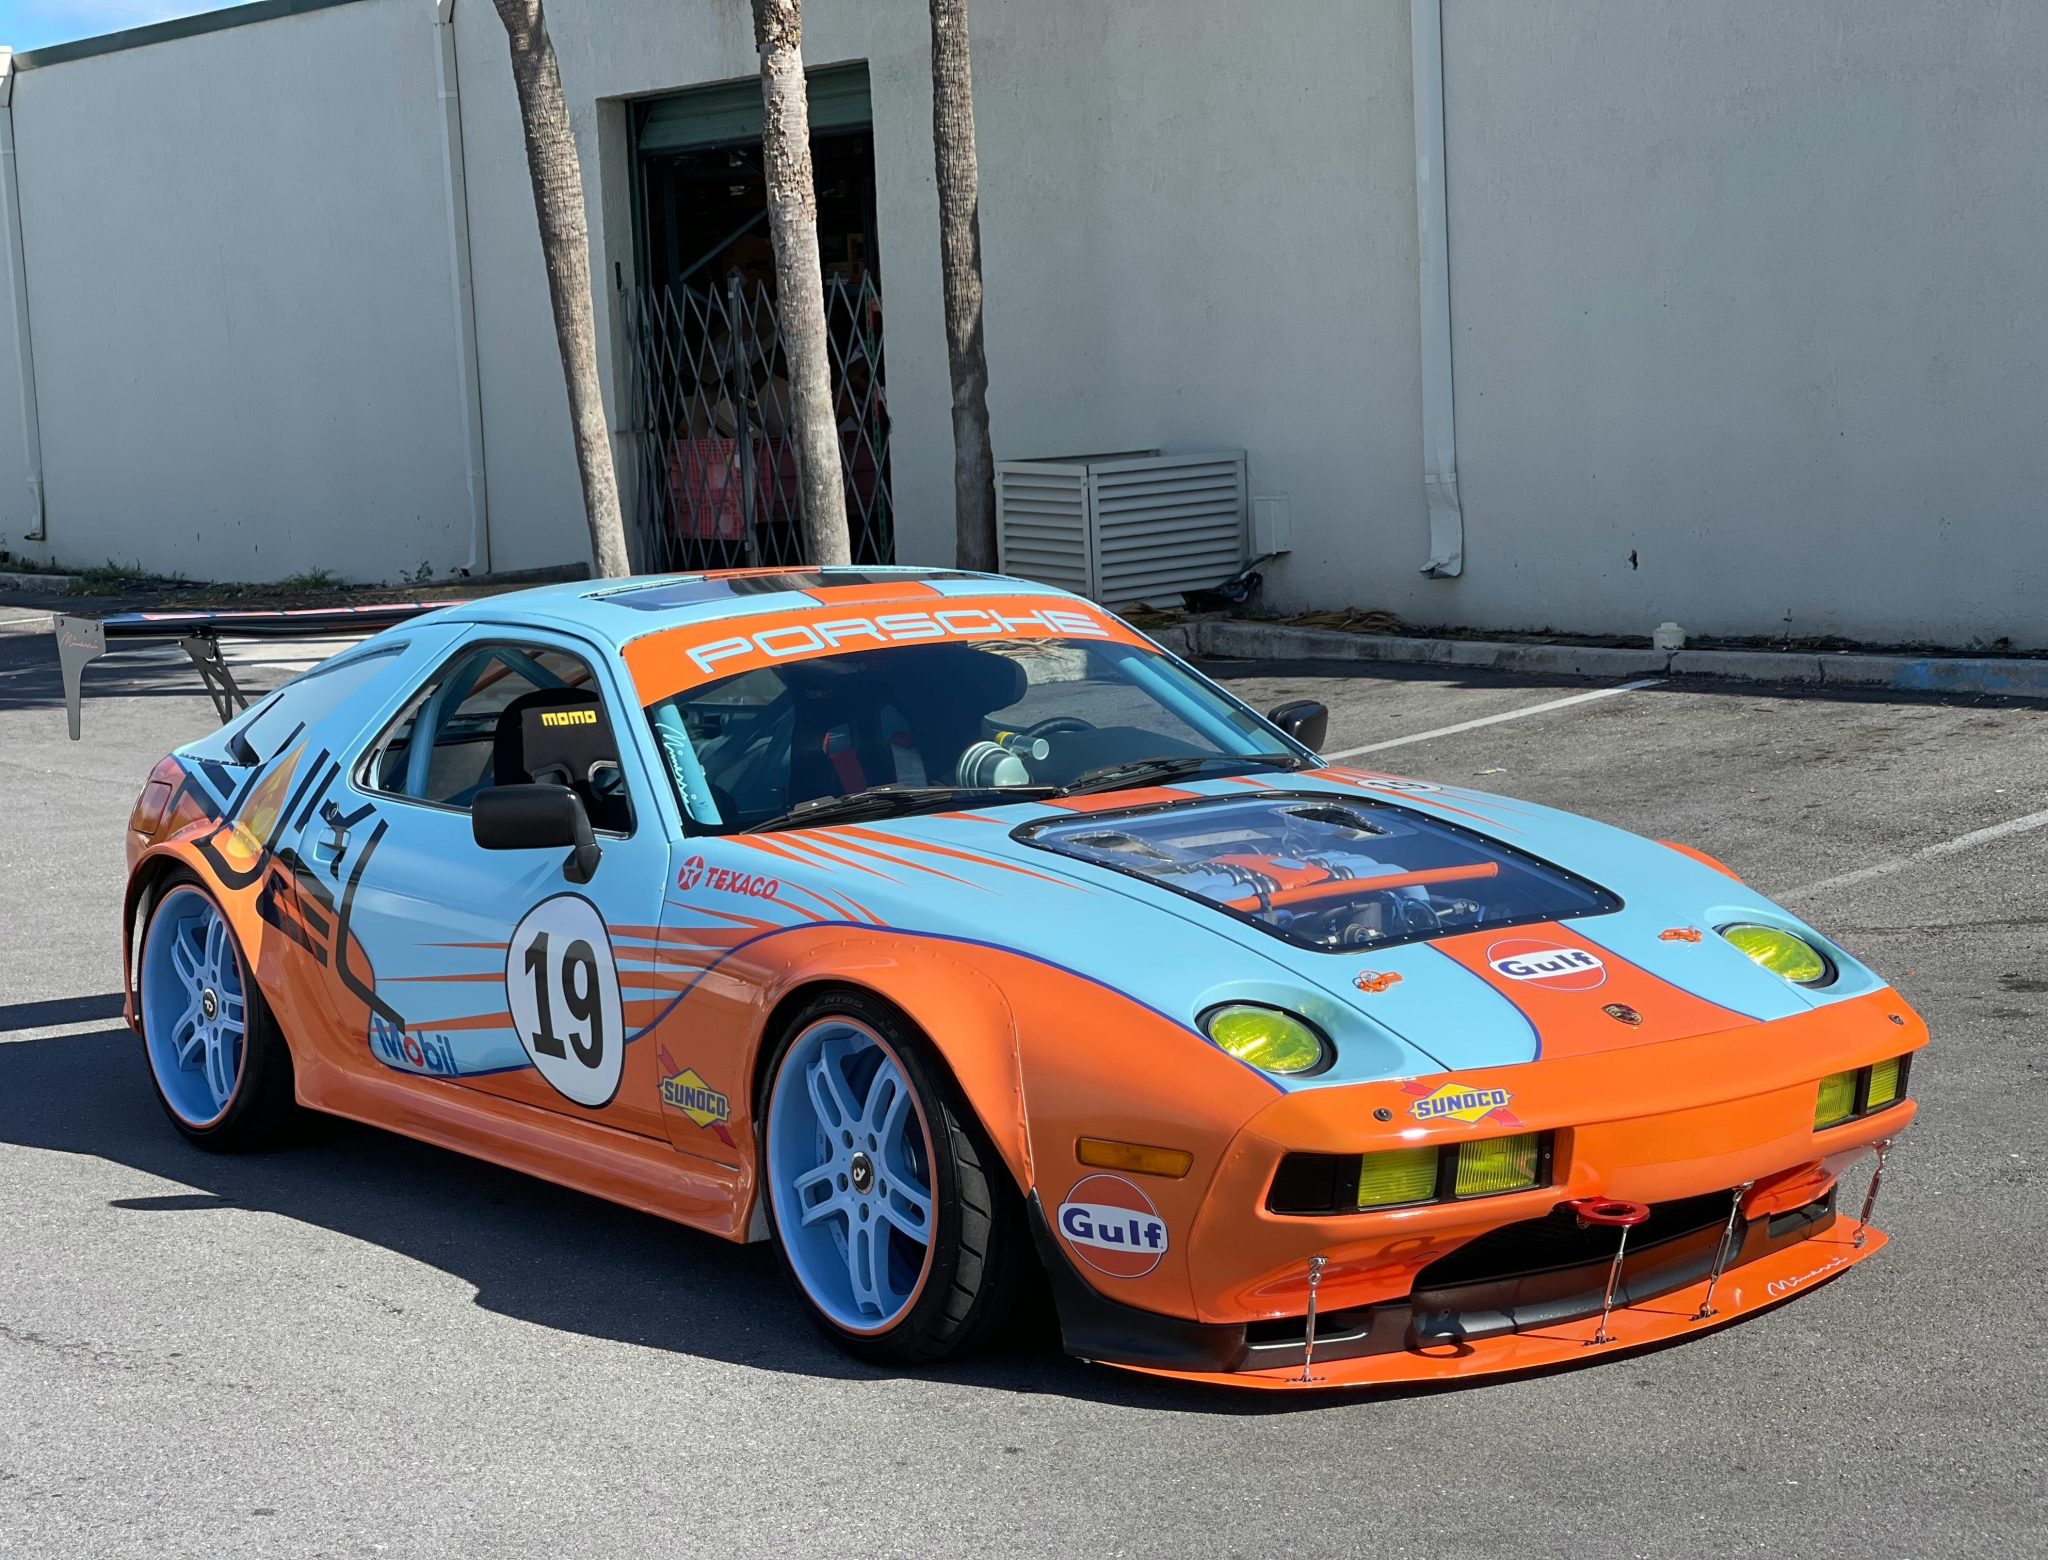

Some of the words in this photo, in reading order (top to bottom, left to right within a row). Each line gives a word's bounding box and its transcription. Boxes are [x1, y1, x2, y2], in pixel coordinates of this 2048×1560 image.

[686, 609, 1110, 673] PORSCHE
[705, 867, 779, 899] TEXACO
[1498, 952, 1595, 976] Gulf
[525, 931, 604, 1069] 19
[374, 1017, 460, 1077] Mobil
[664, 1080, 726, 1118] SUNOCO
[1416, 1090, 1506, 1117] SUNOCO
[1063, 1207, 1162, 1249] Gulf
